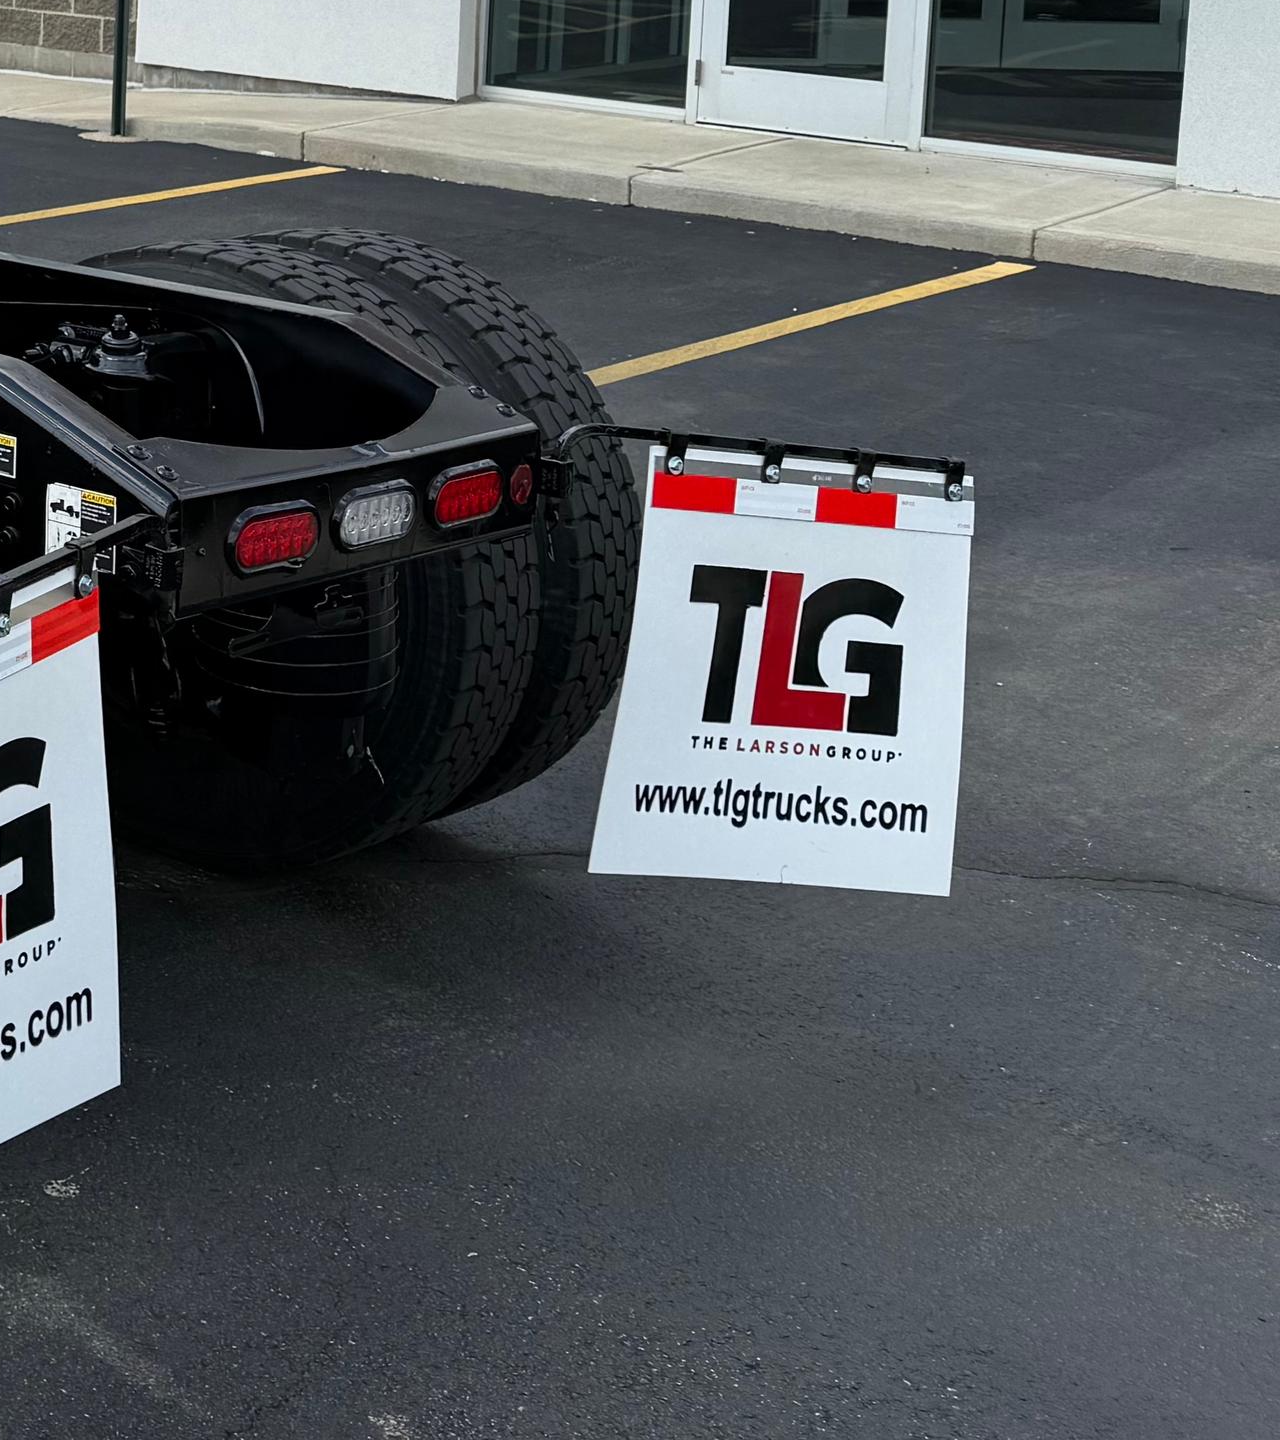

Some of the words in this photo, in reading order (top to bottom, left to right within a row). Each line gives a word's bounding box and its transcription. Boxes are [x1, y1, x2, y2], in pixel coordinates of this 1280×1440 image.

[86, 494, 115, 505] CAUTION
[689, 564, 905, 737] TLG
[690, 735, 729, 751] THE
[736, 738, 821, 758] LARSON
[826, 746, 897, 763] GROUP
[634, 779, 929, 833] www.tlgtrucks.com
